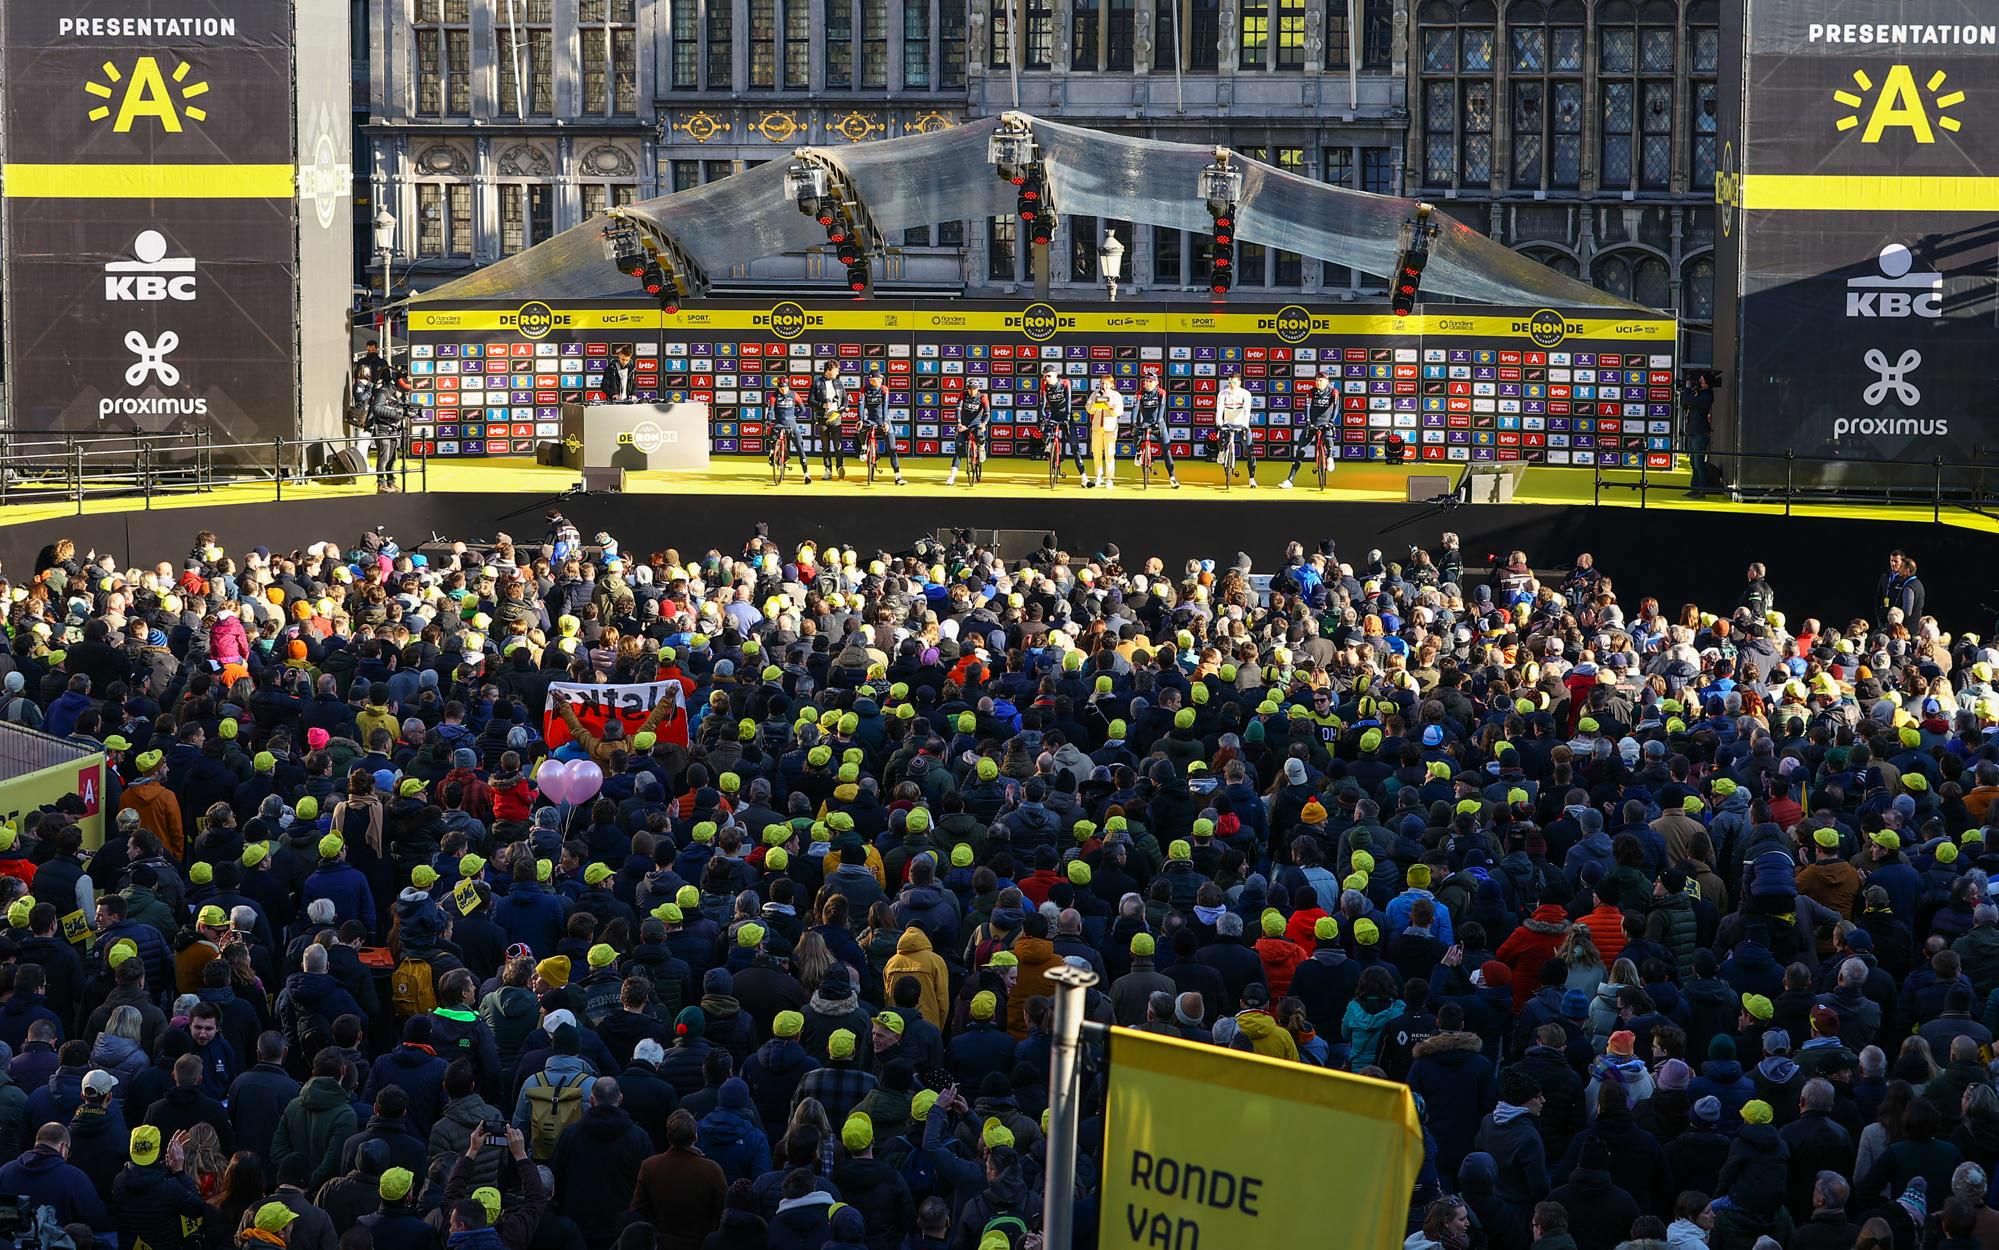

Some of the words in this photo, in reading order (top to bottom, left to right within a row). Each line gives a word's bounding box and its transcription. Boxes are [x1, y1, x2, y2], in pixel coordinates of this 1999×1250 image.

[59, 18, 235, 36] PRESENTATION
[1809, 24, 1995, 44] PRESENTATION
[113, 57, 183, 132] A
[1861, 65, 1934, 143] A
[106, 276, 196, 300] KBC
[1846, 292, 1942, 317] KBC
[500, 316, 516, 324] DE
[520, 315, 550, 325] RON
[554, 316, 570, 324] DE
[752, 316, 770, 324] DE
[773, 315, 802, 325] RON
[806, 316, 823, 325] DE
[1004, 318, 1022, 326] DE
[1025, 317, 1054, 327] RON
[1058, 318, 1075, 327] DE
[1258, 320, 1275, 328] DE
[1279, 319, 1308, 329] RON
[1312, 320, 1329, 329] DE
[1512, 323, 1529, 331] DE
[1533, 323, 1562, 333] RON
[1566, 324, 1583, 333] DE
[518, 345, 526, 355] A
[771, 345, 780, 354] A
[1023, 347, 1031, 356] A
[1276, 349, 1284, 359] A
[1530, 354, 1539, 363] A
[672, 360, 681, 368] N
[922, 362, 932, 370] N
[1175, 364, 1184, 373] N
[1430, 367, 1440, 375] N
[443, 378, 452, 388] A
[567, 377, 577, 385] N
[697, 376, 706, 386] A
[948, 379, 956, 388] A
[1072, 379, 1081, 388] N
[1201, 381, 1209, 390] A
[1455, 384, 1464, 393] A
[1579, 387, 1589, 396] N
[593, 393, 601, 402] A
[100, 398, 207, 418] proximus
[1351, 399, 1359, 408] A
[492, 409, 502, 418] N
[746, 408, 756, 417] N
[1605, 405, 1613, 414] A
[997, 411, 1006, 419] N
[1504, 418, 1513, 426] N
[1834, 417, 1948, 436] proximus
[518, 426, 526, 435] A
[1022, 428, 1031, 437] A
[1275, 430, 1284, 439] A
[1529, 435, 1538, 444] A
[1654, 438, 1664, 447] N
[923, 443, 931, 452] A
[1175, 445, 1184, 454] A
[1430, 448, 1438, 458] A
[84, 778, 95, 804] A
[1131, 1149, 1263, 1216] RONDE
[1127, 1203, 1199, 1250] VAN
